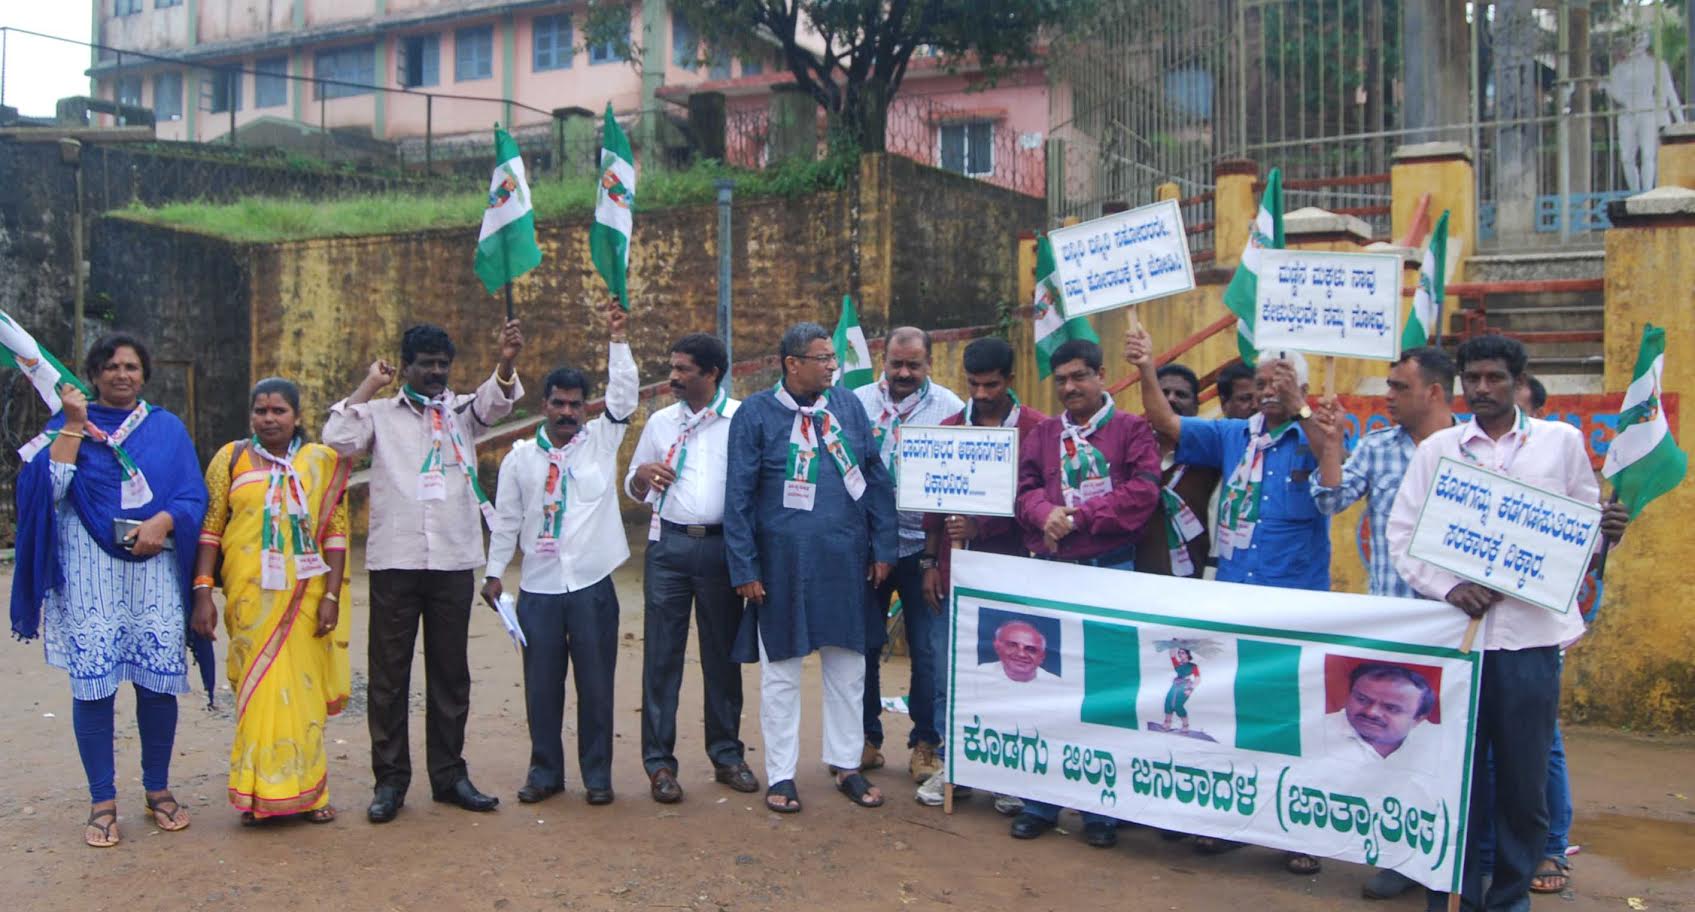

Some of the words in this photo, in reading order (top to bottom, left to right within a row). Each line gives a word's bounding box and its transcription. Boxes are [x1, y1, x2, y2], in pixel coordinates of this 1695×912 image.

[1065, 279, 1086, 304] ನಮ್ಮ
[1352, 270, 1375, 295] ನಾವು
[1324, 307, 1345, 338] ನಮ್ಮ
[963, 714, 1049, 776] ಕೊಡಗು
[1062, 743, 1118, 808] ಜಿಲ್ಲಾ
[1130, 750, 1259, 817] ಜನತಾದಳ
[1275, 766, 1450, 871] (ಜಾತ್ಯಾತೀತ)
